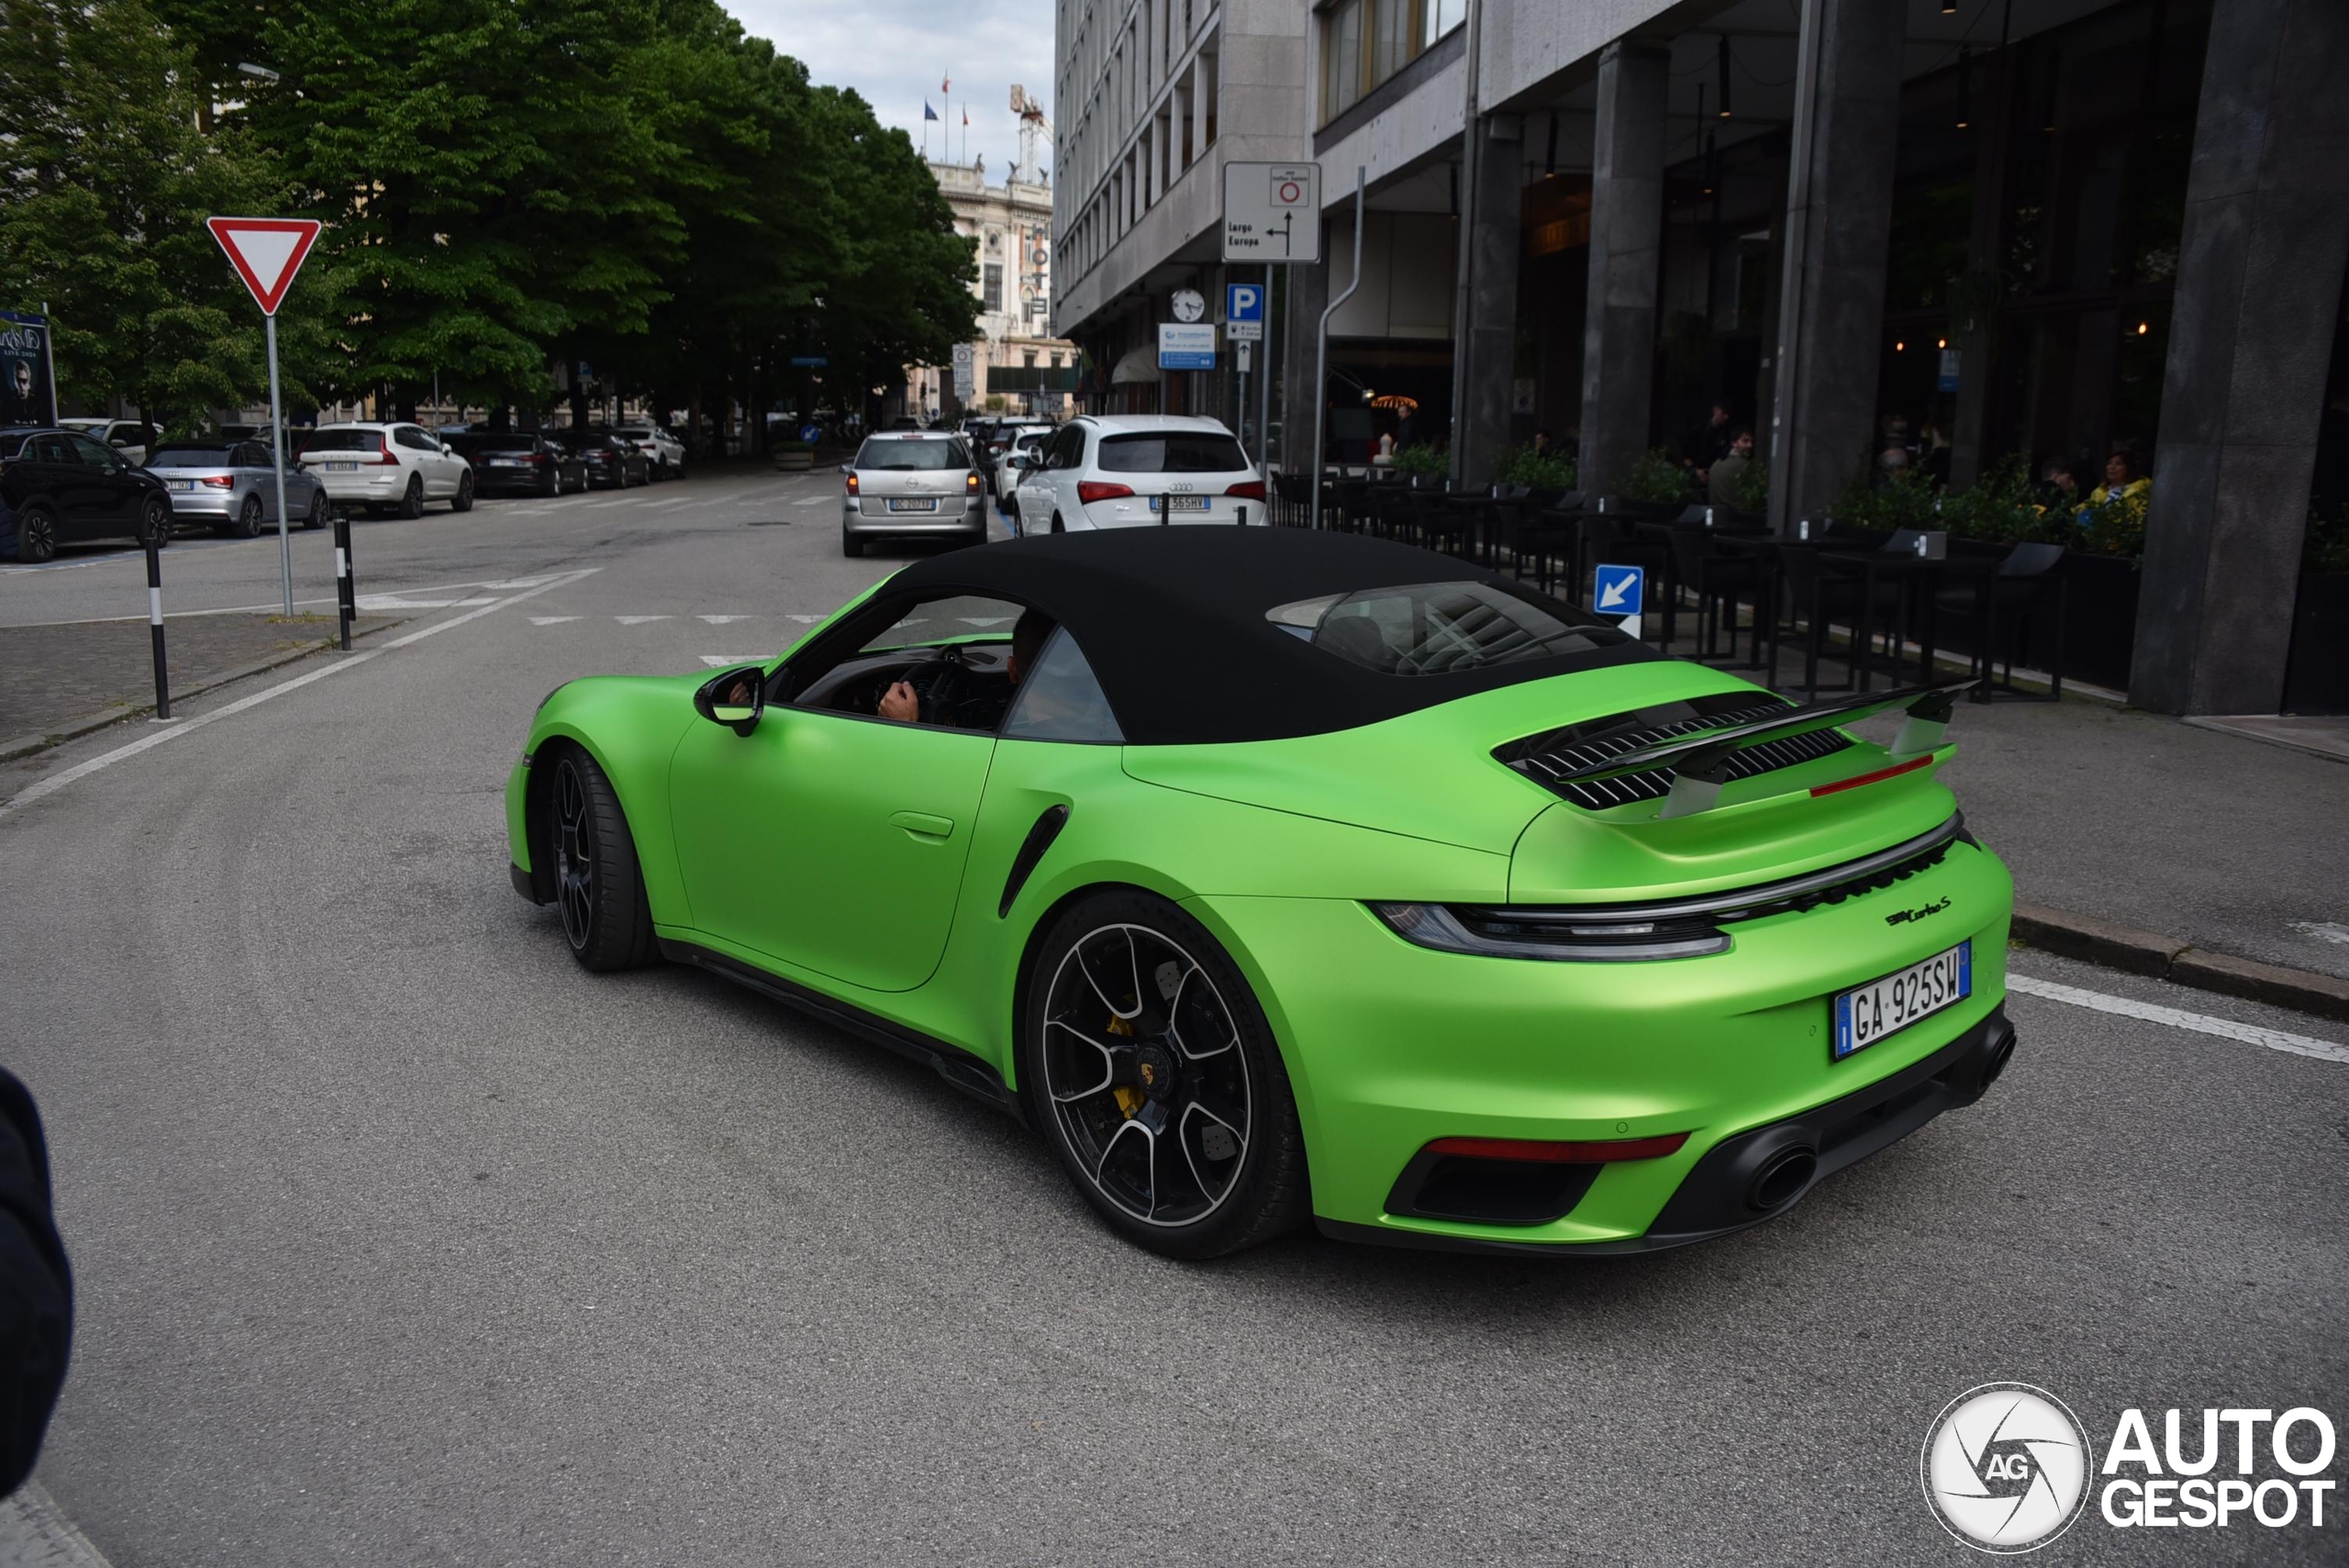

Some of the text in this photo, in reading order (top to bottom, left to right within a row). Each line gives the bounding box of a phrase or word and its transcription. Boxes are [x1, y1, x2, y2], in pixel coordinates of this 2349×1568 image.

[1229, 221, 1252, 233] Largo
[1229, 235, 1259, 247] Europa
[1234, 288, 1256, 317] P
[1173, 496, 1203, 508] 365HV
[1941, 895, 1952, 909] S
[1855, 987, 1884, 1041] GA
[1892, 952, 1957, 1024] 925SW
